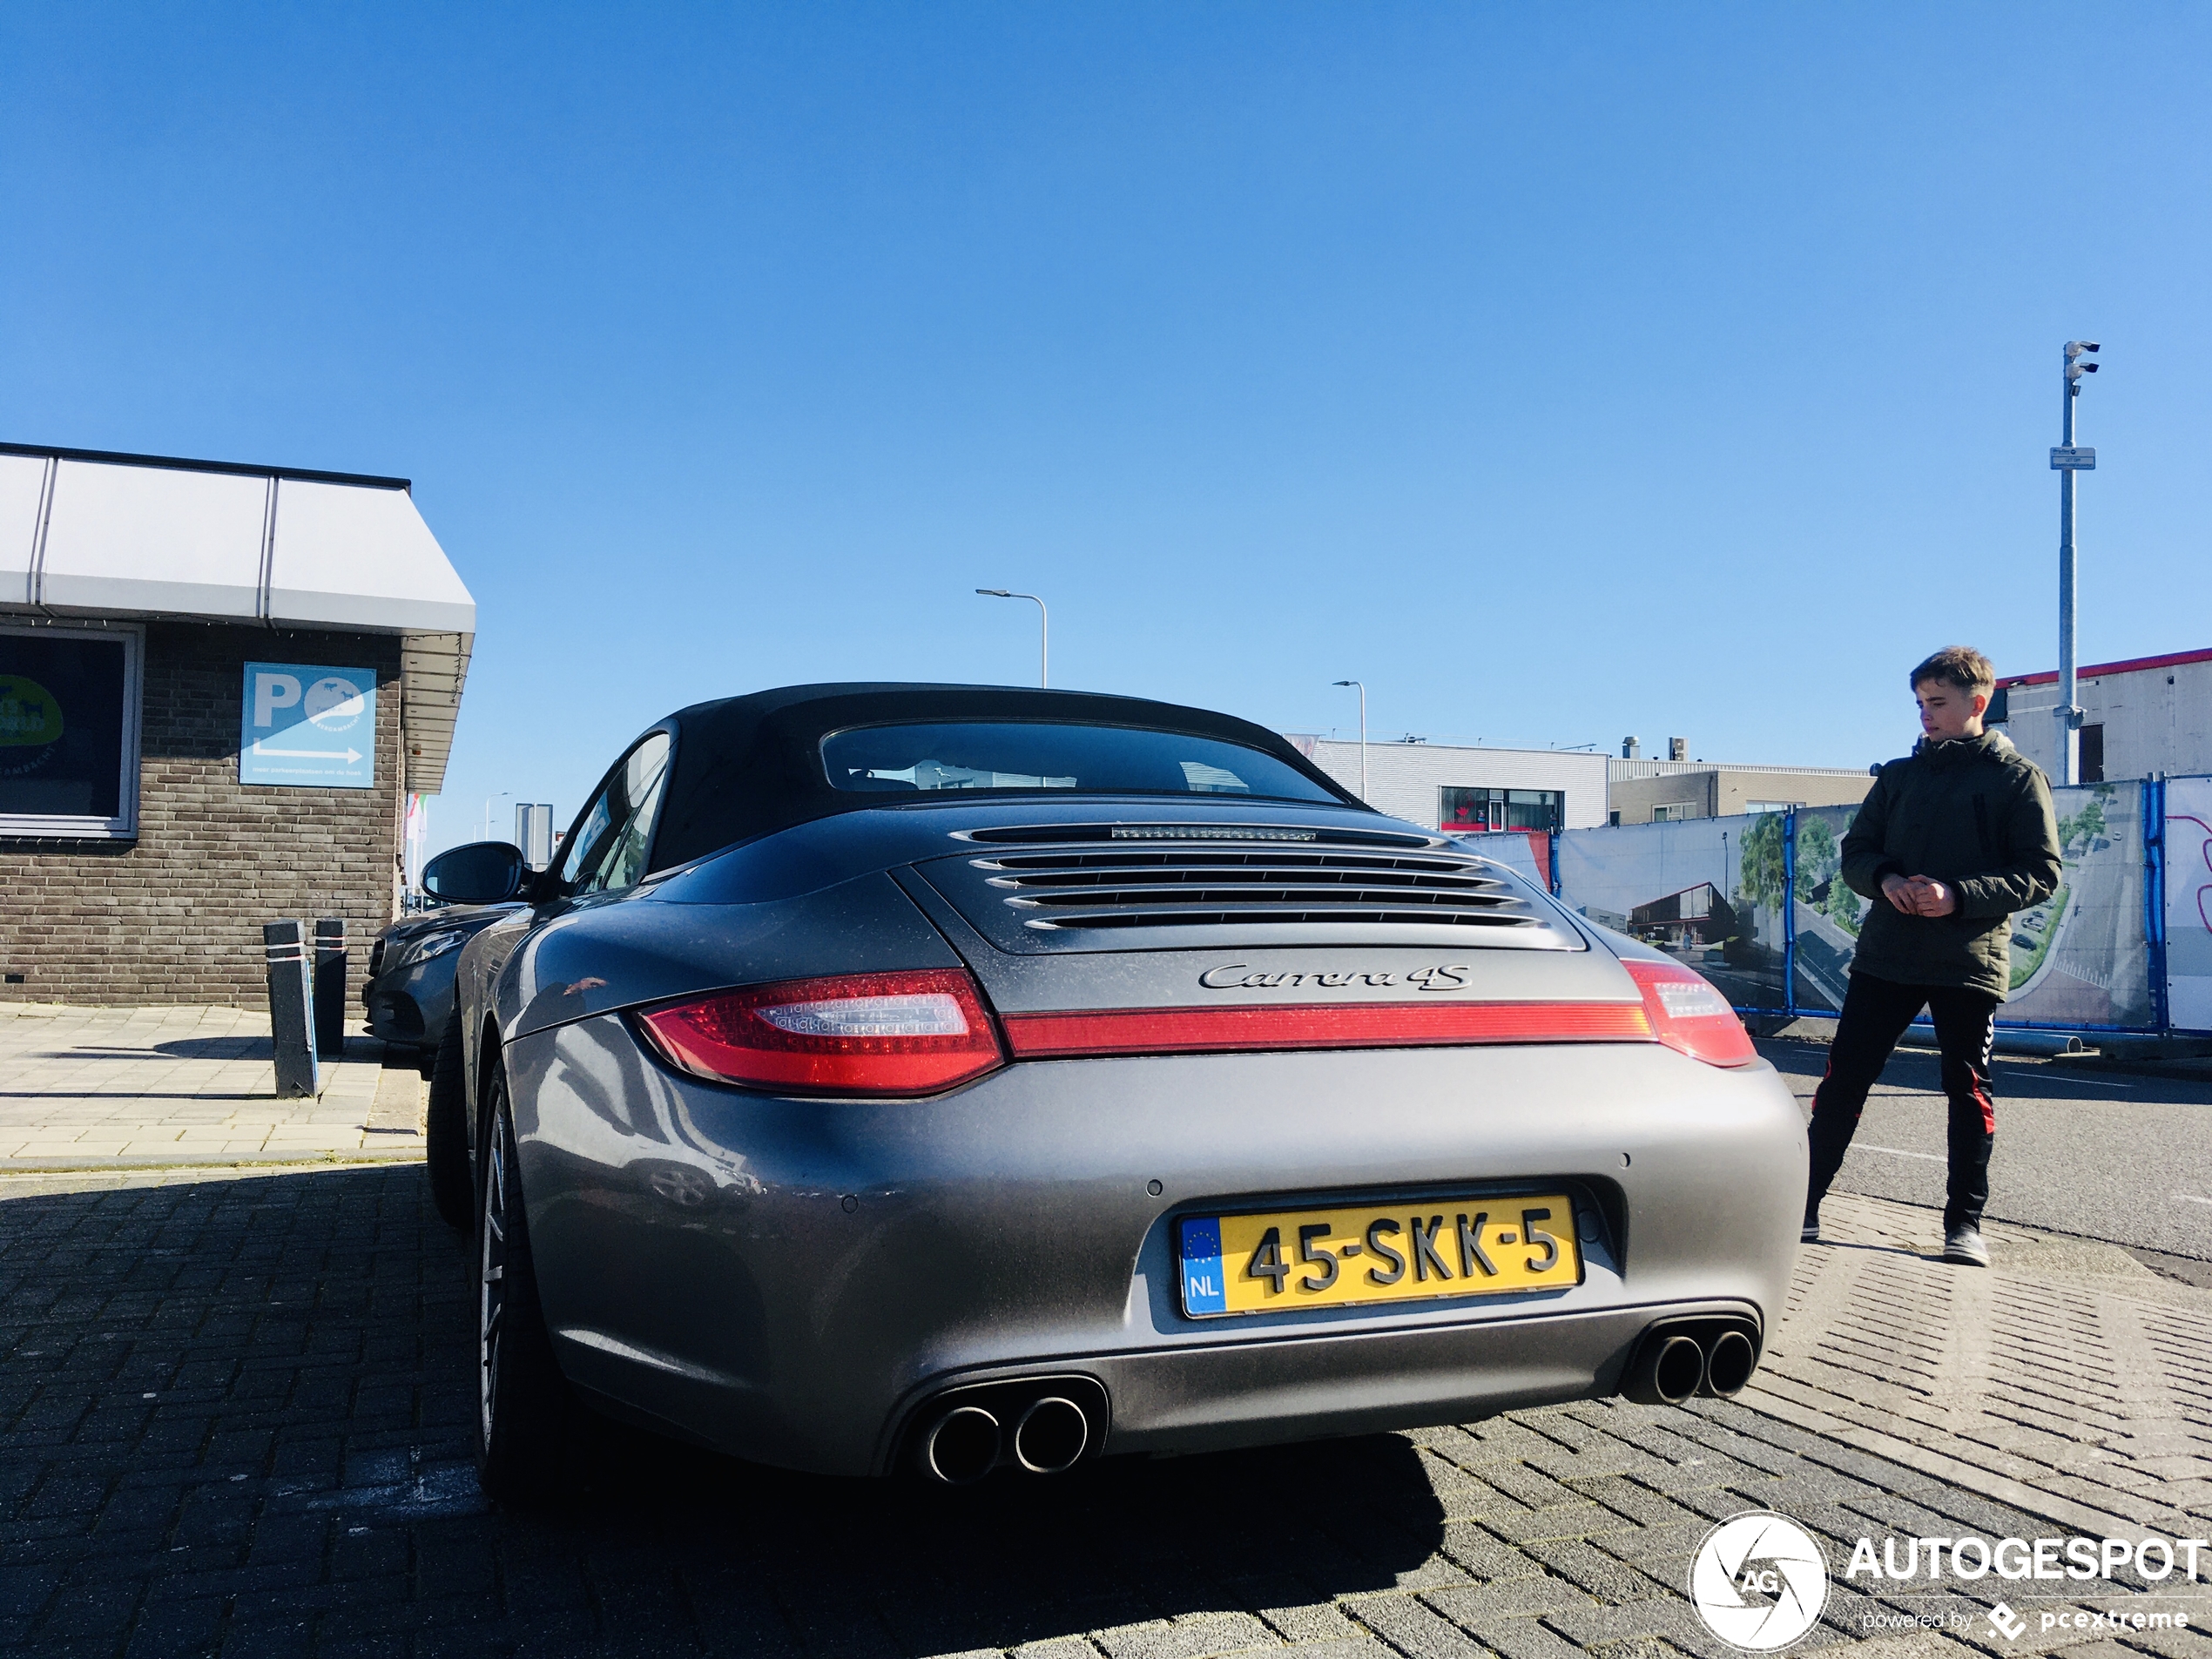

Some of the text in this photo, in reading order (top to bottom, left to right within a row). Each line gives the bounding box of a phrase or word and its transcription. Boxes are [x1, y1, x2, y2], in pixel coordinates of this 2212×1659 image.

[253, 672, 302, 727] P
[316, 715, 360, 732] BERGAMBACHT
[1198, 963, 1473, 991] Carrera 4S
[1249, 1207, 1559, 1294] 45-SKK-5
[1190, 1276, 1219, 1298] NL
